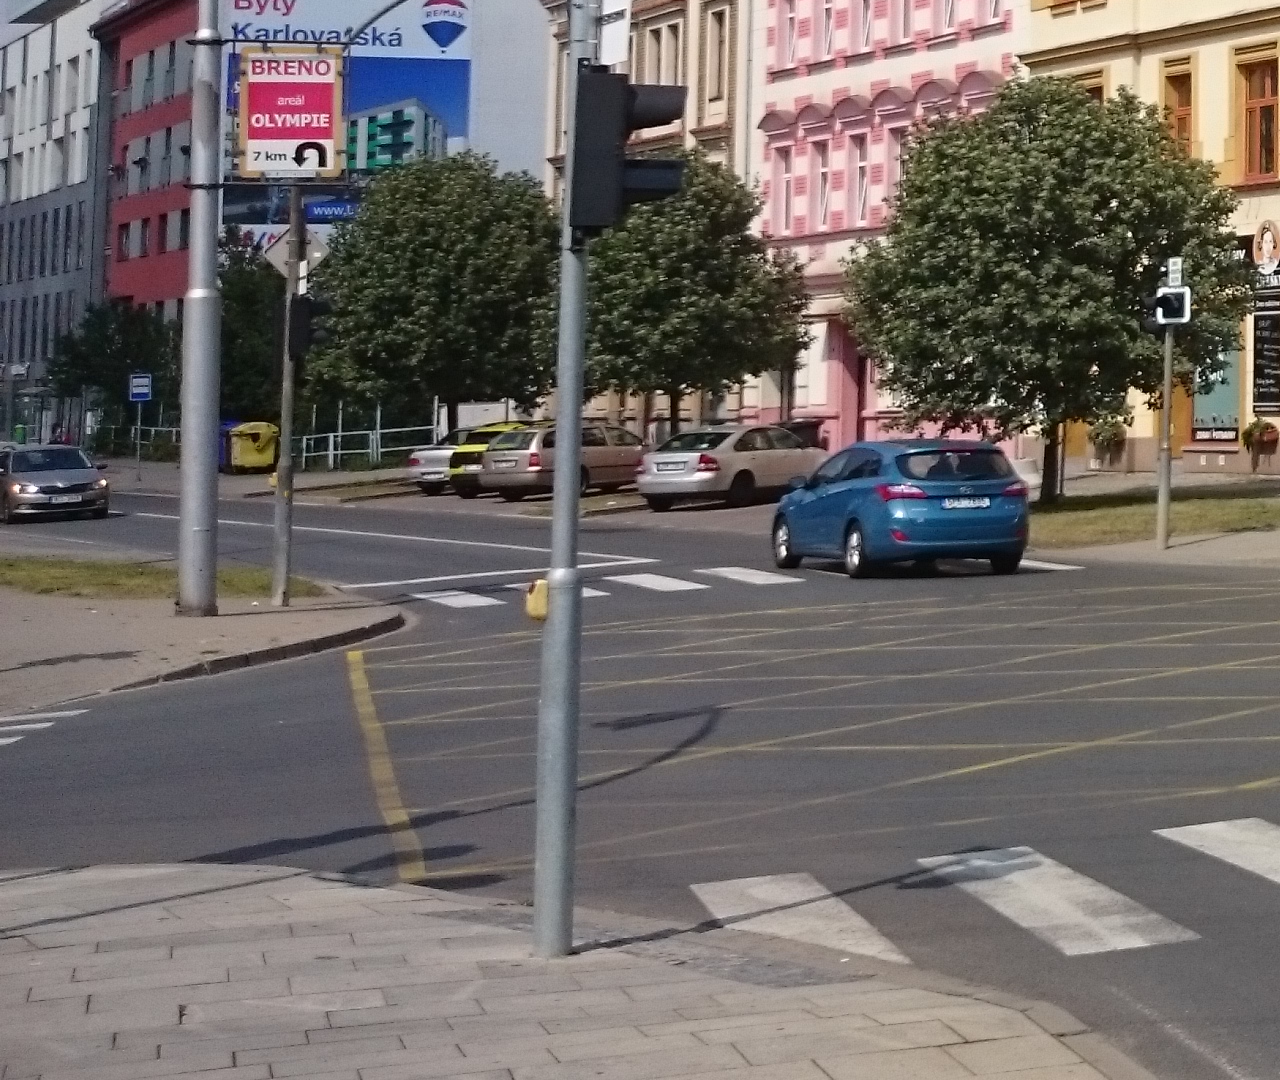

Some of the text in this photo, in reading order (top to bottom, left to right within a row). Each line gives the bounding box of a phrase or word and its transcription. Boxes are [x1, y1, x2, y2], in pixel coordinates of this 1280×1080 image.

[425, 8, 465, 20] RE/MAX
[251, 59, 331, 76] BRENO
[277, 95, 305, 107] areál
[251, 113, 330, 128] OLYMPIE
[252, 150, 287, 161] 7 km
